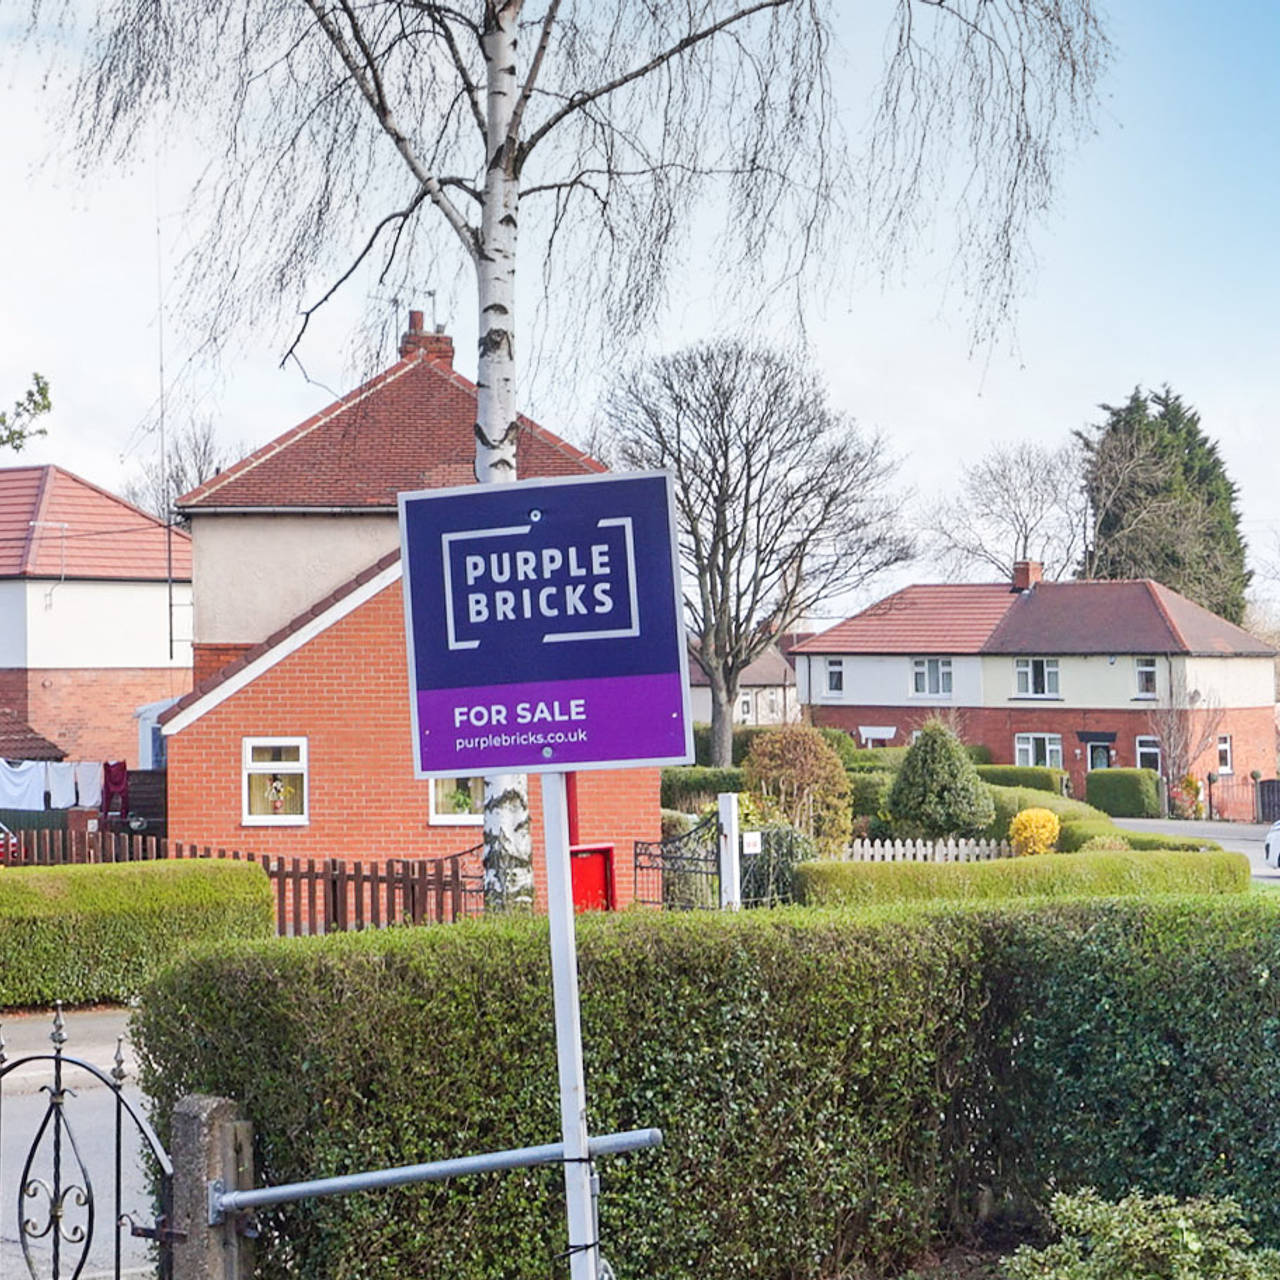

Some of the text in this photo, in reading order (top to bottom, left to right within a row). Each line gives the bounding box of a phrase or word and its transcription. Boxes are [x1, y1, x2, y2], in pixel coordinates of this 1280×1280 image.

[466, 544, 610, 585] PURPLE
[468, 582, 613, 623] BRICKS
[454, 699, 587, 729] FOR SALE
[455, 728, 588, 752] purplebricks.co.uk
